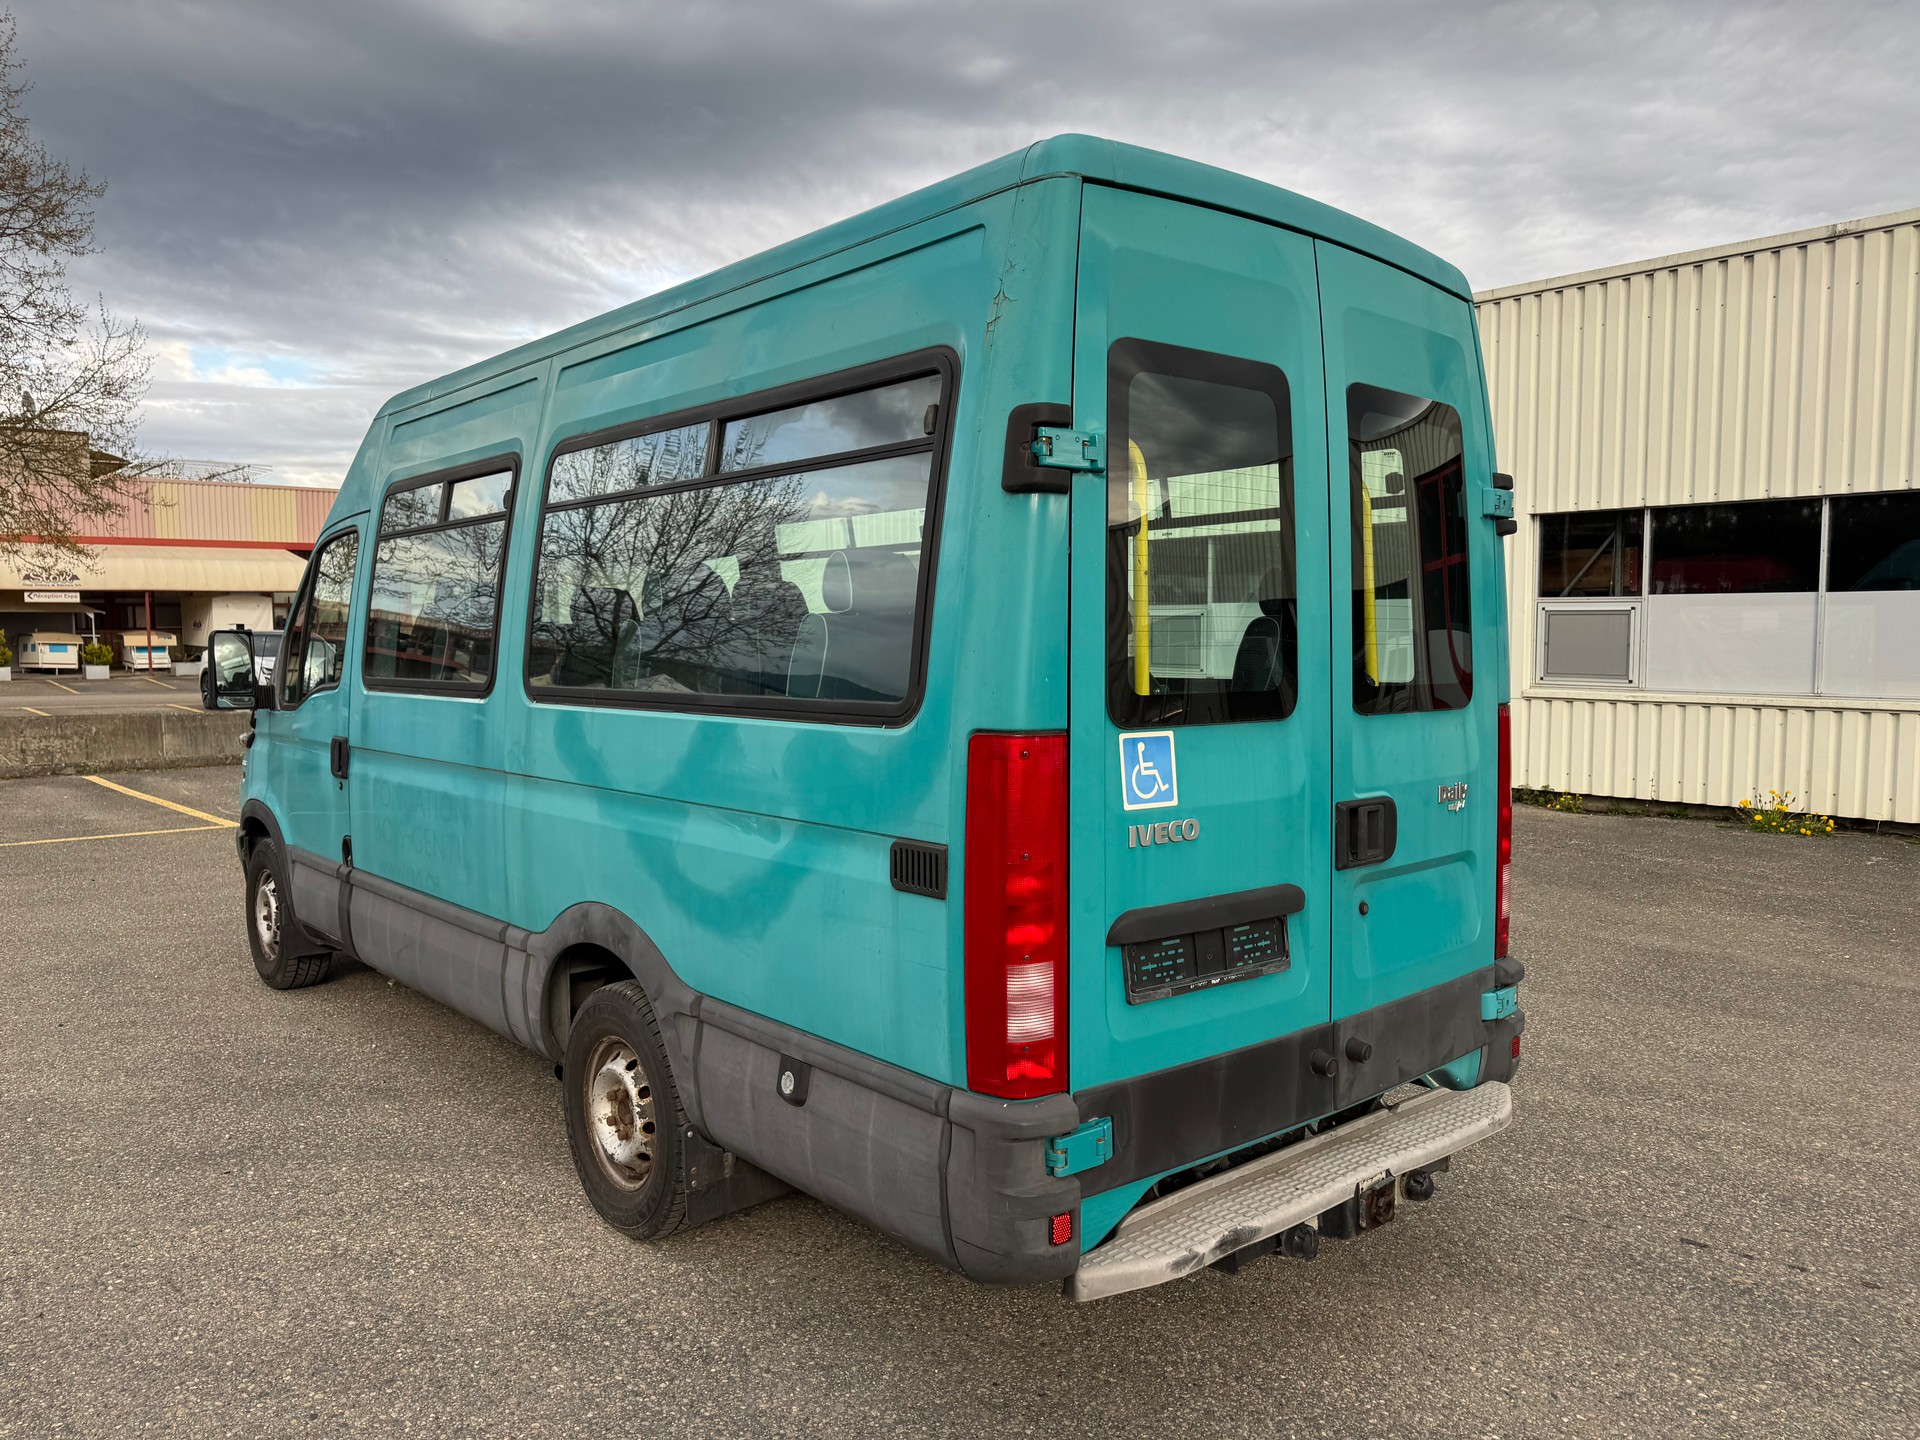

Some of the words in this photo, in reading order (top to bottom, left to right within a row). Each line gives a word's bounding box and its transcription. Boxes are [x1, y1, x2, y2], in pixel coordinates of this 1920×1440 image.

[29, 570, 74, 583] Stoll
[1438, 781, 1468, 803] Daily
[1128, 818, 1200, 849] IVECO
